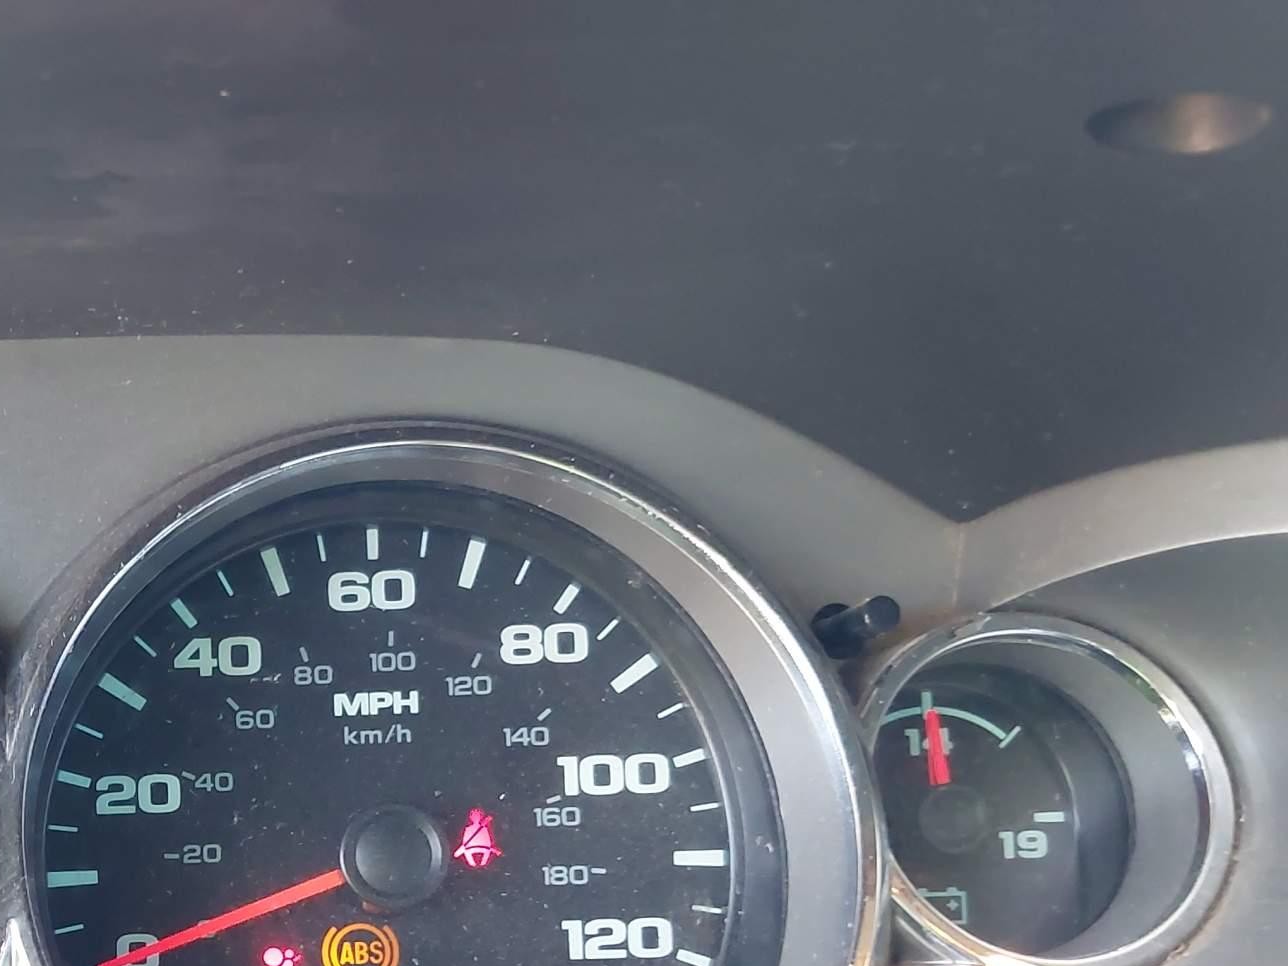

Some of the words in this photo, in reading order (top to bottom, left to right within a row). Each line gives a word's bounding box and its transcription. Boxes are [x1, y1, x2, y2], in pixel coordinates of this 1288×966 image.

[327, 570, 415, 612] 60
[499, 624, 589, 665] 80
[173, 636, 262, 677] 40
[368, 652, 416, 673] 100
[293, 665, 333, 687] 80
[445, 676, 493, 697] 120
[333, 691, 419, 716] MPH
[234, 708, 275, 730] 60
[343, 726, 412, 745] km/h
[502, 725, 550, 747] 140
[194, 772, 234, 792] 40
[556, 754, 670, 795] 100
[95, 774, 181, 814] 20
[533, 806, 580, 827] 160
[182, 844, 222, 864] 20
[998, 830, 1049, 859] 19
[542, 865, 589, 886] 180
[561, 917, 673, 960] 120
[340, 941, 384, 965] ABS
